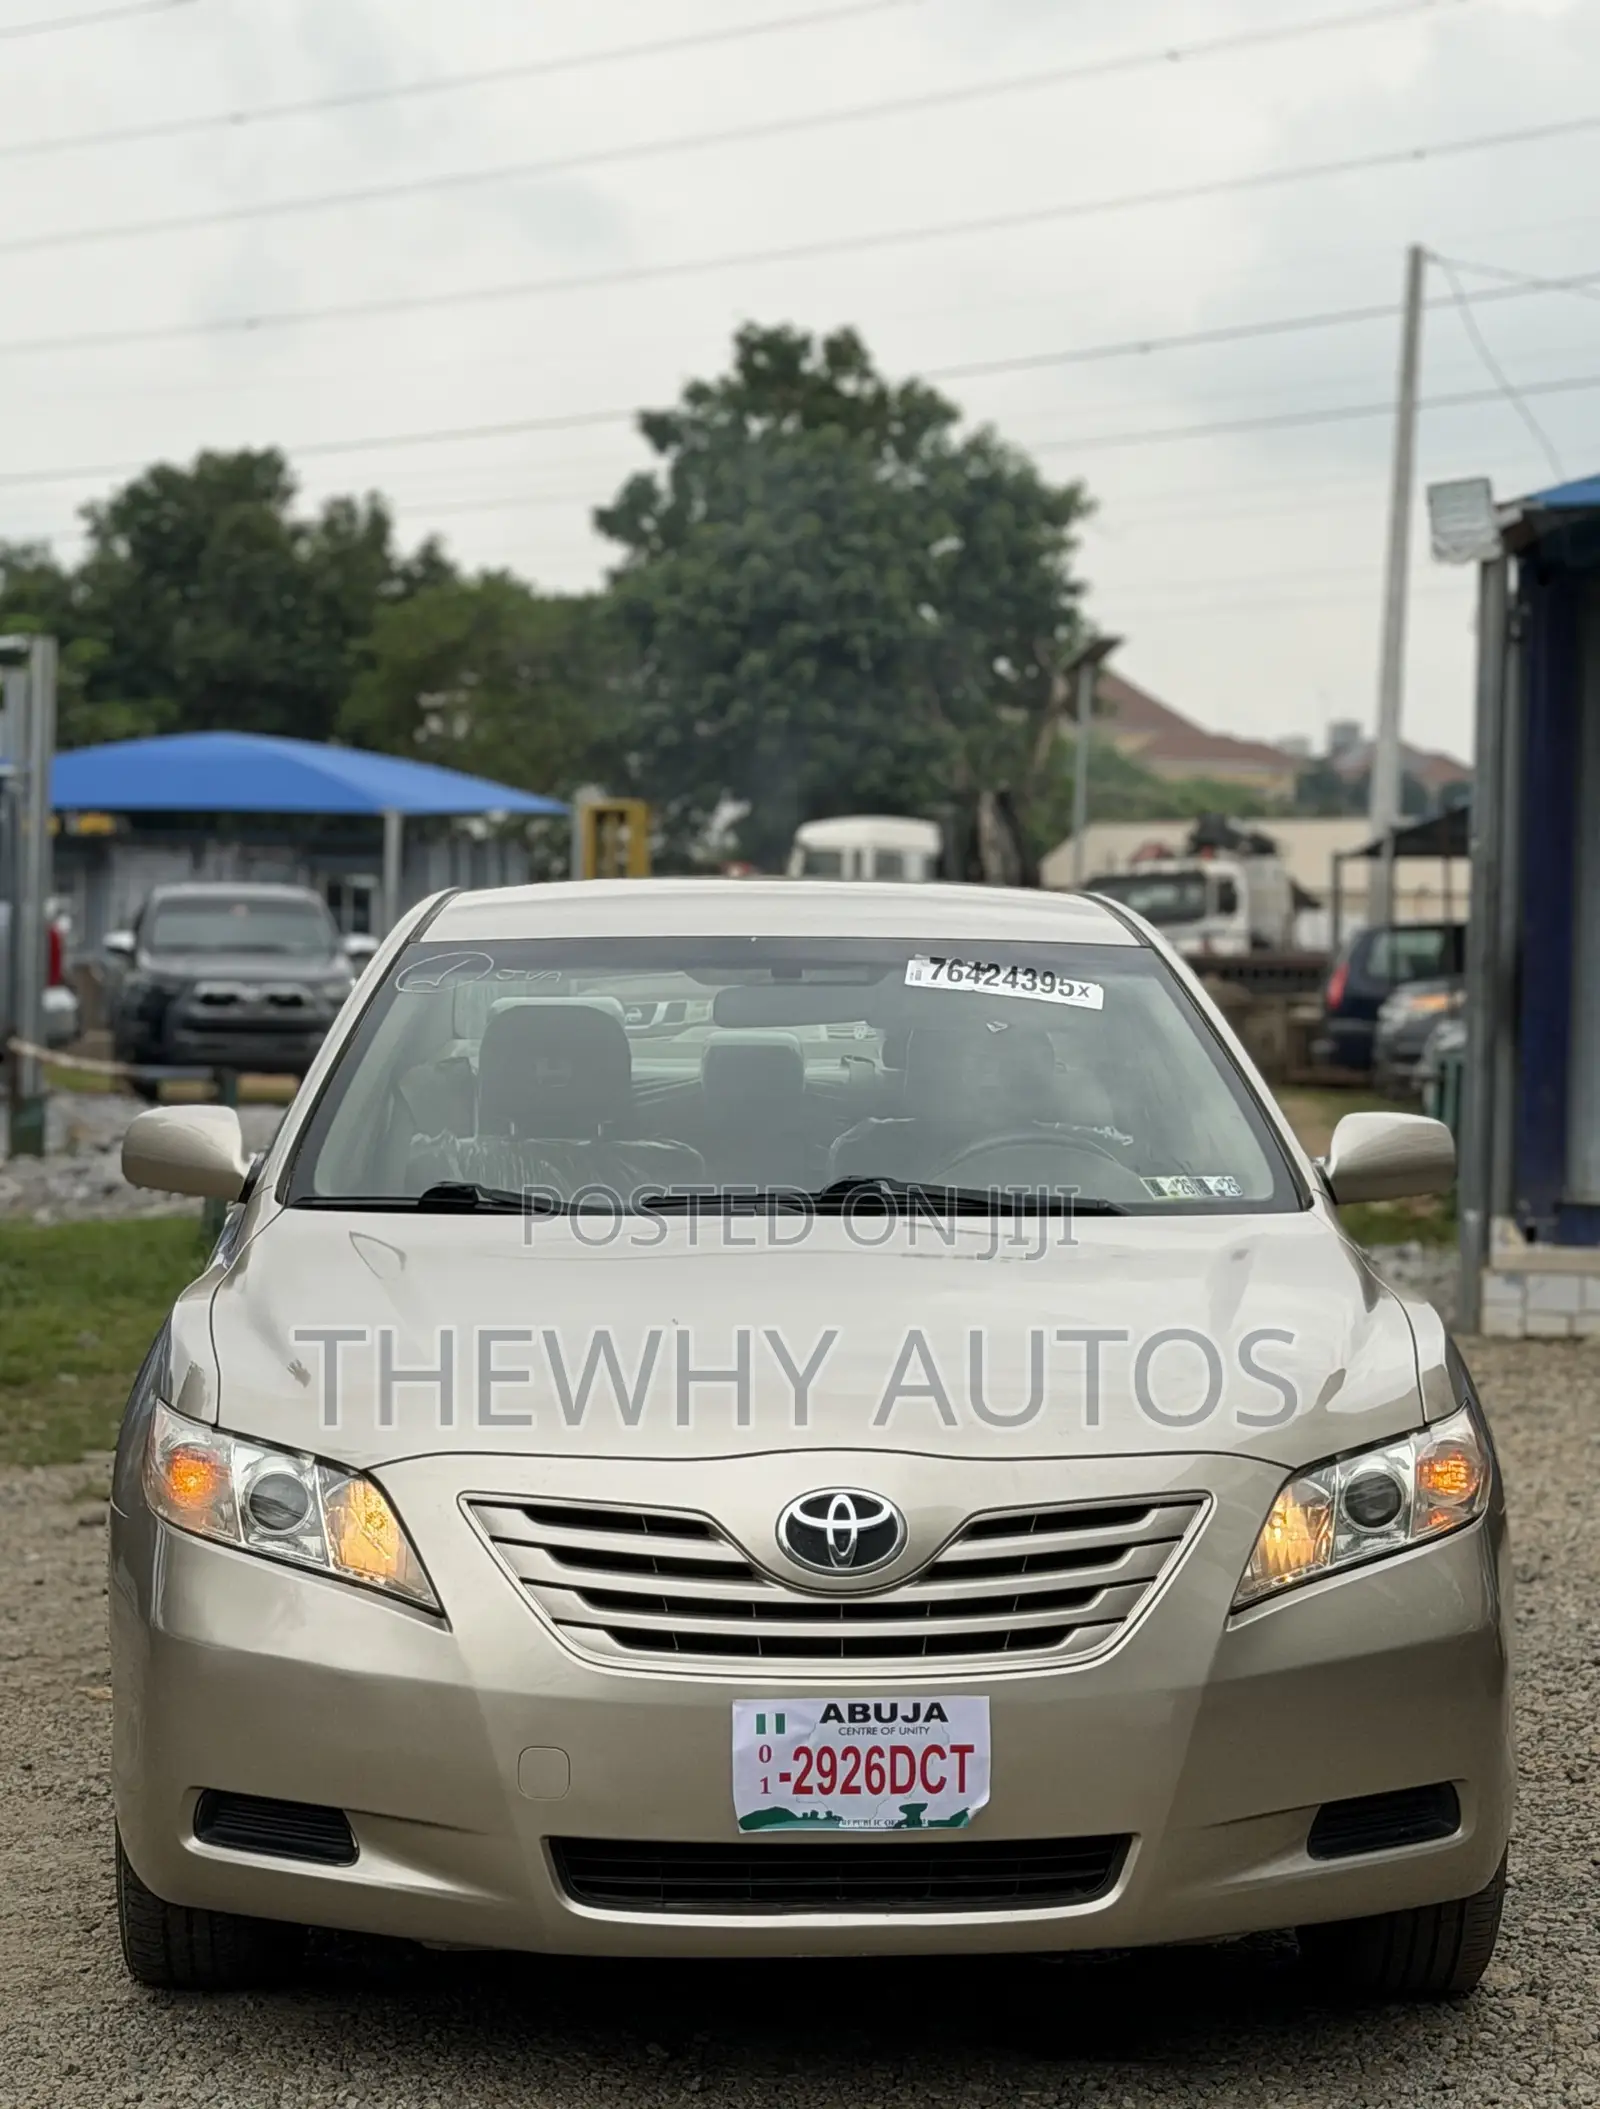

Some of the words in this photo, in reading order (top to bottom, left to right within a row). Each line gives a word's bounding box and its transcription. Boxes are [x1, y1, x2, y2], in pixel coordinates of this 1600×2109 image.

[819, 1702, 949, 1724] ABUJA
[838, 1726, 878, 1736] CENTRE
[880, 1726, 896, 1736] OF
[899, 1726, 931, 1736] UNITY
